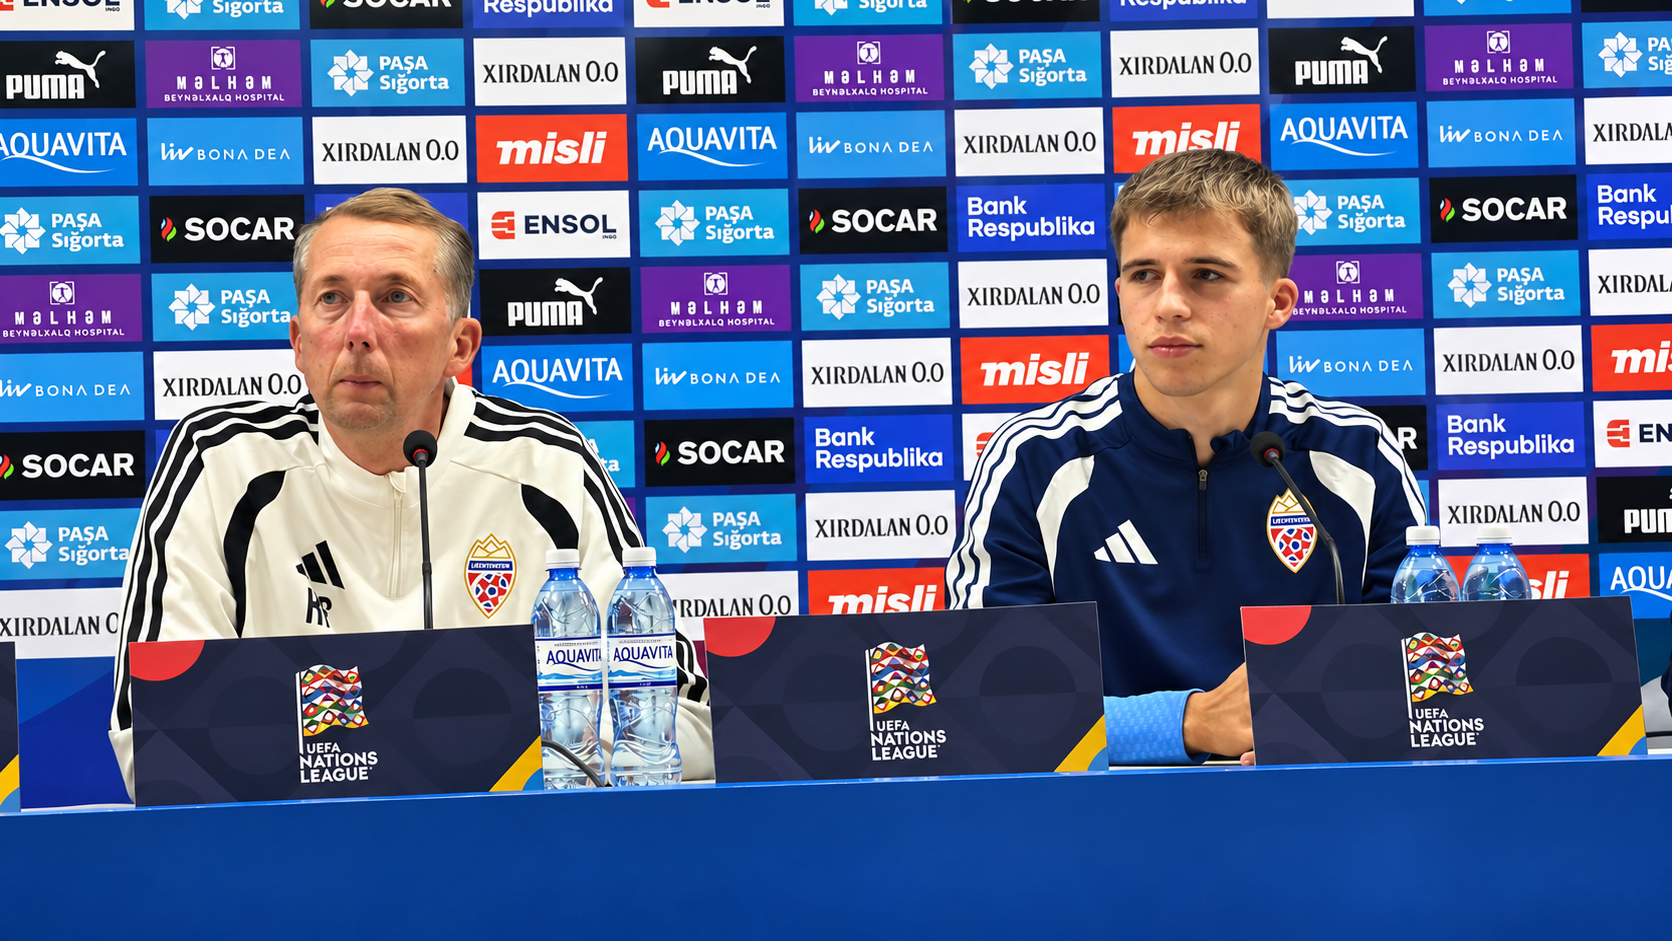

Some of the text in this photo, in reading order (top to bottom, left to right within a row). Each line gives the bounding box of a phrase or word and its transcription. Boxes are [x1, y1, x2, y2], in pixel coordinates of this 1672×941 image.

[1648, 37, 1672, 51] PA
[379, 55, 428, 74] PAŞA
[1019, 49, 1066, 67] PAŞA
[1119, 52, 1252, 75] XIRDALAN 0.0
[483, 60, 618, 83] XIRDALAN 0.0
[1295, 60, 1369, 85] PUMA
[1510, 75, 1558, 84] HOSPITAL
[6, 74, 85, 99] PUMA
[662, 70, 737, 95] PUMA
[880, 87, 928, 95] HOSPITAL
[236, 93, 284, 101] HOSPITAL
[648, 126, 777, 151] AQUAVITA
[1132, 121, 1240, 155] misli
[1280, 116, 1408, 142] AQUAVITA
[1474, 130, 1522, 143] BONA
[1529, 129, 1563, 141] DEA
[322, 139, 459, 162] XIRDALAN 0.0
[496, 131, 607, 164] misli
[844, 142, 892, 153] BONA
[899, 141, 933, 153] DEA
[964, 131, 1096, 154] XIRDALAN 0.0
[198, 149, 248, 160] BONA
[255, 148, 290, 160] DEA
[1337, 194, 1384, 212] PAŞA
[1597, 183, 1657, 203] Bank
[705, 205, 754, 224] PAŞA
[967, 196, 1027, 216] Bank
[1461, 196, 1567, 222] SOCAR
[51, 213, 102, 231] PAŞA
[524, 214, 617, 235] ENSOL
[831, 208, 938, 233] SOCAR
[1598, 205, 1672, 229] Respu
[184, 217, 294, 241] SOCAR
[968, 217, 1095, 242] Respublika
[1497, 266, 1545, 285] PAŞA
[1597, 274, 1672, 294] XIRDAL
[221, 289, 270, 307] PAŞA
[866, 279, 915, 297] PAŞA
[967, 283, 1100, 306] XIRDALAN 0.0
[507, 301, 583, 327] PUMA
[1360, 306, 1407, 314] HOSPITAL
[727, 317, 775, 326] HOSPITAL
[75, 328, 125, 336] HOSPITAL
[1324, 361, 1372, 373] BONA
[1379, 359, 1413, 371] DEA
[1443, 349, 1575, 372] XIRDALAN 0.0
[1611, 341, 1672, 374] mi
[492, 358, 623, 383] AQUAVITA
[690, 373, 739, 385] BONA
[746, 372, 780, 384] DEA
[811, 362, 944, 385] XIRDALAN 0.0
[980, 352, 1090, 386] misli
[35, 384, 87, 396] BONA
[94, 384, 131, 396] DEA
[162, 373, 301, 397] XIRDALAN 0.0
[1447, 413, 1506, 434] Bank
[815, 427, 875, 447] Bank
[1448, 435, 1575, 459] Respublika
[677, 440, 785, 465] SOCAR
[815, 448, 943, 473] Respublika
[22, 453, 134, 478] SOCAR
[713, 511, 761, 530] PAŞA
[1448, 500, 1580, 524] XIRDALAN 0.0
[58, 526, 109, 546] PAŞA
[815, 514, 948, 538] XIRDALAN 0.0
[672, 594, 791, 617] RDALAN 0.0
[828, 584, 937, 614] misli
[0, 616, 100, 636] XIRDALAN
[613, 646, 673, 661] AQUAVITA
[1415, 708, 1449, 719] UEFA
[876, 720, 910, 731] UEFA
[1409, 718, 1484, 734] NATIONS
[306, 742, 341, 754] UEFA
[870, 730, 947, 746] NATIONS
[1410, 733, 1476, 748] LEAGUE
[300, 751, 378, 769] NATIONS
[871, 745, 938, 761] LEAGUE
[300, 767, 369, 783] LEAGUE
